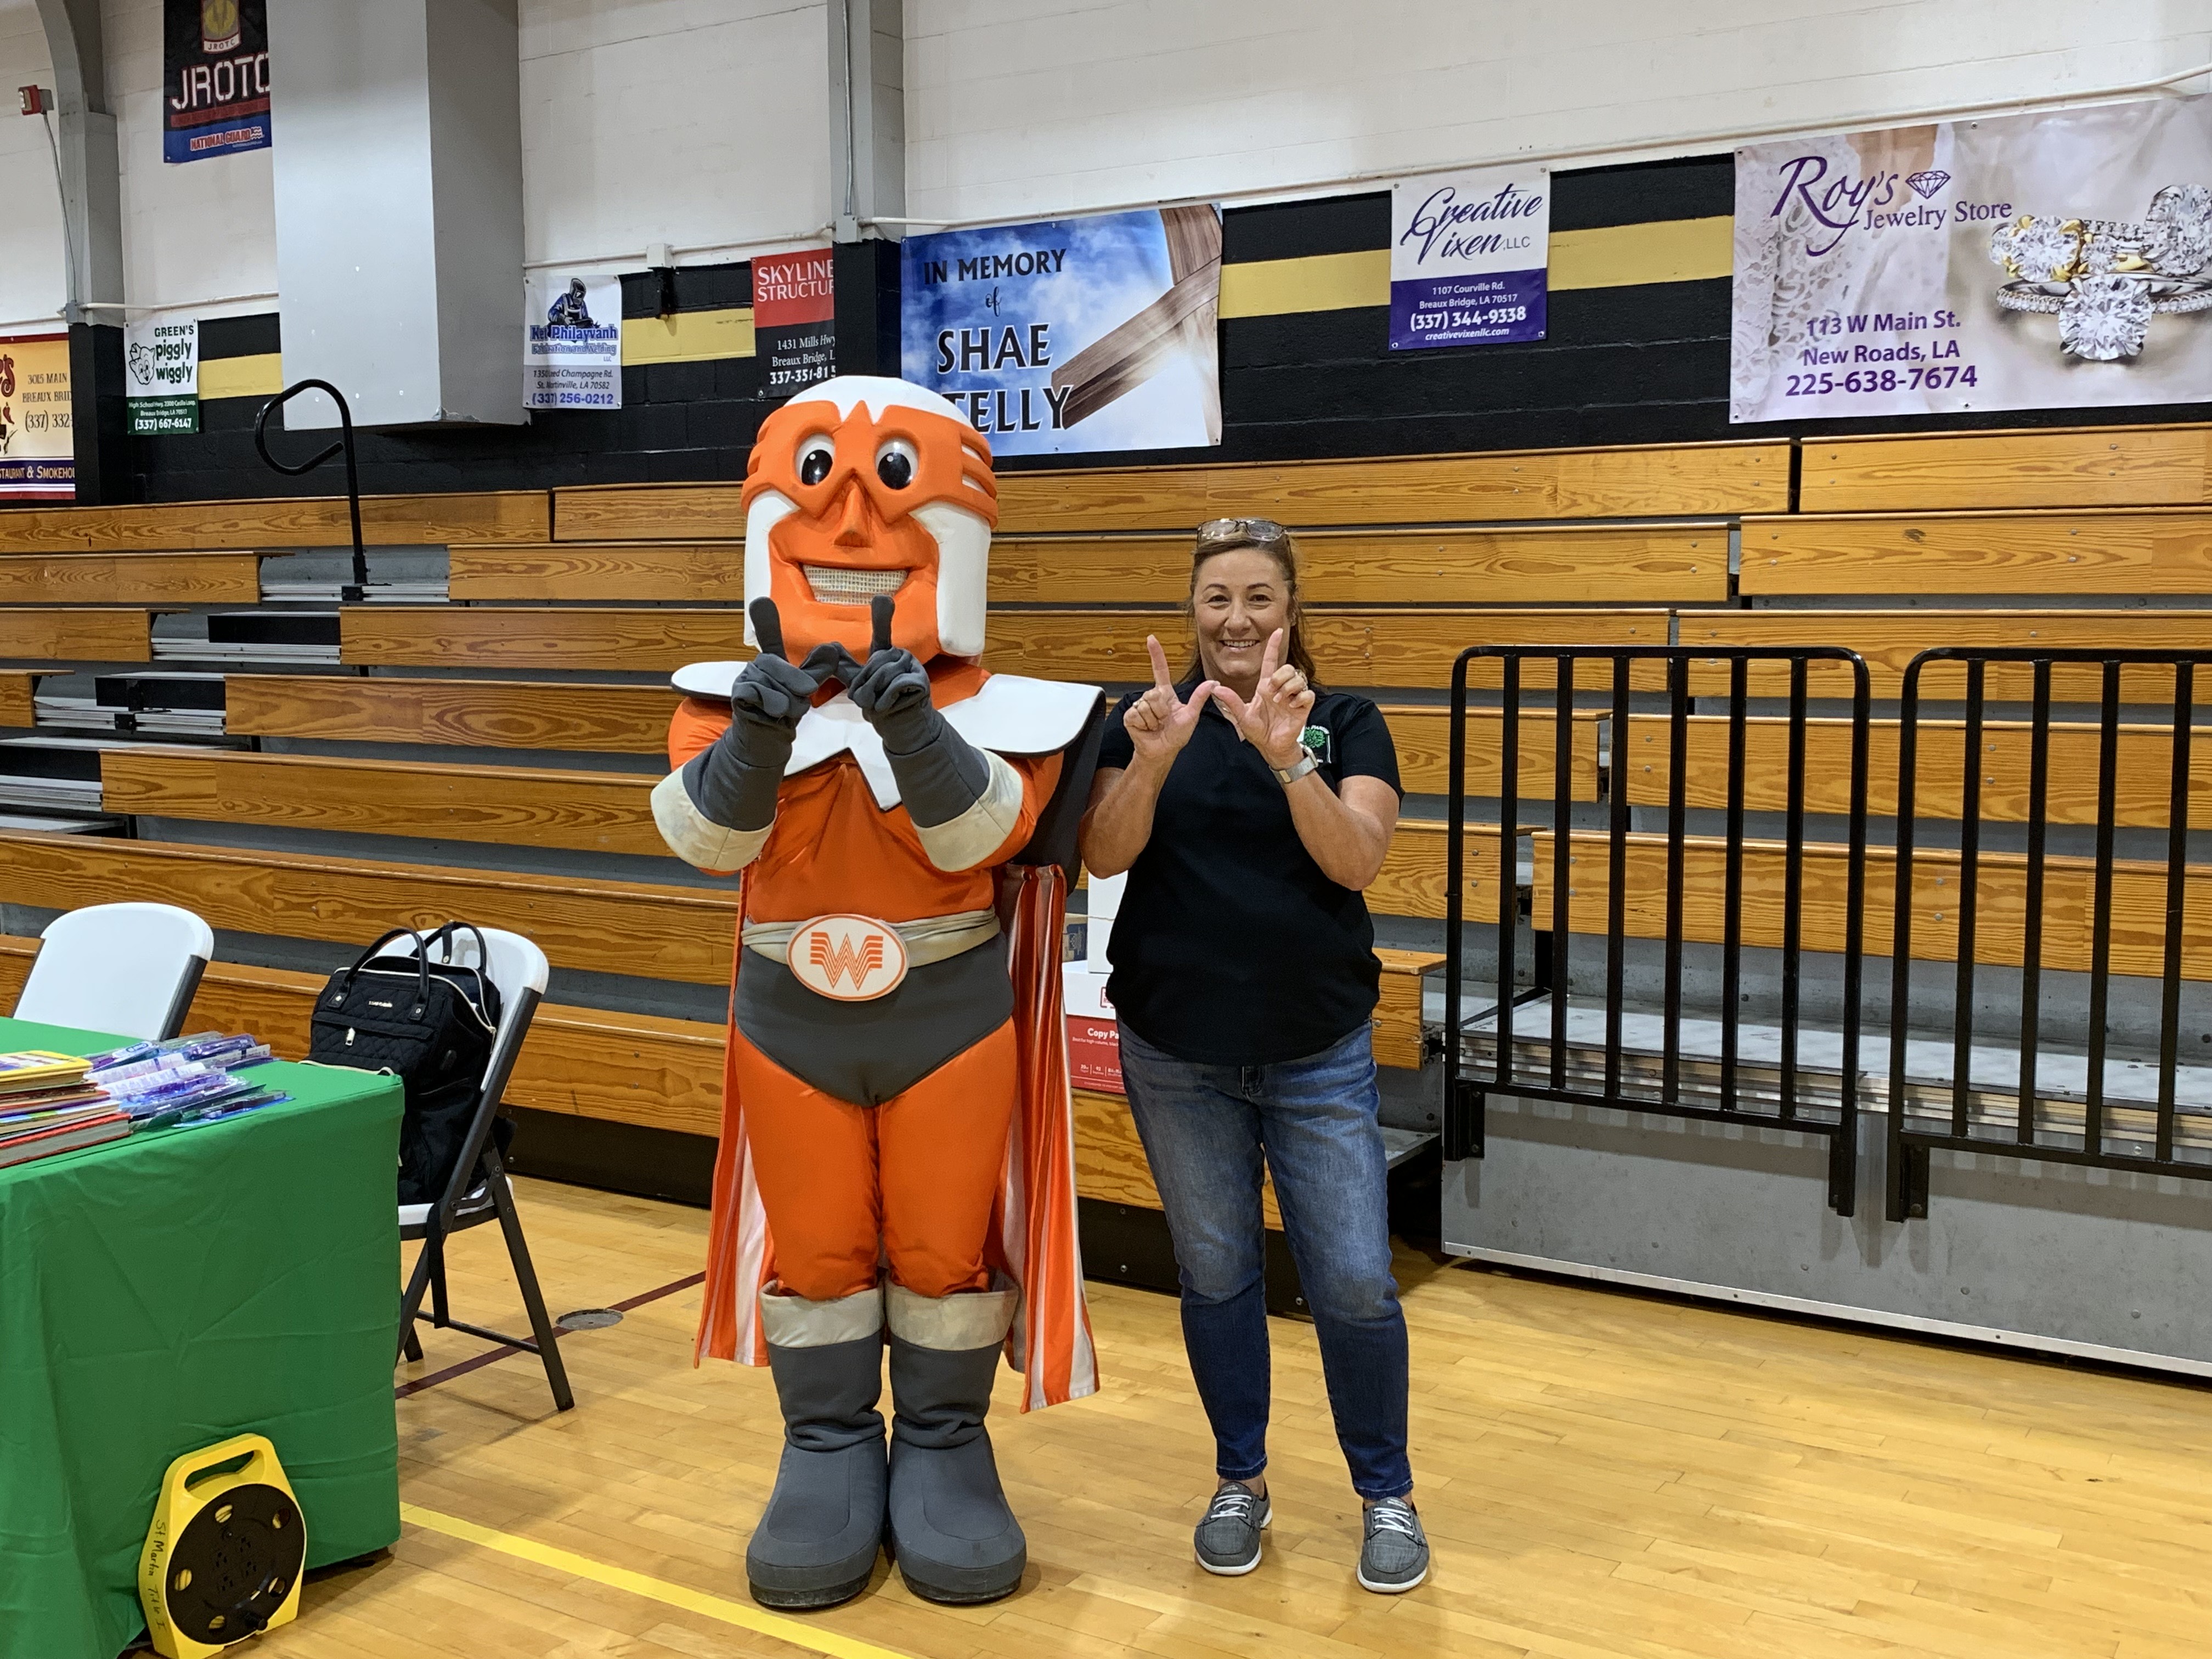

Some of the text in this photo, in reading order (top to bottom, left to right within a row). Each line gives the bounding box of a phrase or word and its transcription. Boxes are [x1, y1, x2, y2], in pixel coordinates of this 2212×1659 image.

[207, 38, 235, 50] JROTC
[171, 53, 270, 110] JROTC
[190, 133, 225, 151] NATIONAL
[224, 128, 251, 145] GUARD
[1410, 183, 1544, 237] Creative
[1770, 156, 1898, 257] Roy's
[1864, 200, 2013, 230] Jewelry Store
[1400, 216, 1504, 265] Vixen
[758, 259, 834, 285] SKYLINE
[924, 248, 1067, 285] IN MEMORY
[1432, 281, 1505, 295] 1107 Courville Rd.
[985, 286, 1002, 317] of
[1419, 294, 1518, 309] Breaux Bridge, LA 70517
[1410, 306, 1527, 332] (337) 344-9338
[1807, 310, 1961, 336] 113 W Main St.
[154, 325, 194, 337] GREEN'S
[550, 324, 619, 344] Philayvanh
[1425, 328, 1510, 341] creativevixenllc.com
[155, 338, 192, 360] piggly
[777, 338, 797, 351] 1431
[799, 335, 819, 349] Mills
[936, 322, 1054, 375] SHAE
[1803, 340, 1961, 366] New Roads, LA
[771, 356, 802, 368] Breaux
[803, 351, 827, 365] Bridge,
[46, 373, 67, 384] MAIN
[155, 362, 193, 384] wiggly
[561, 369, 603, 380] Champagne
[604, 369, 613, 378] Rd.
[1785, 365, 1978, 397] 225-638-7674
[22, 392, 52, 403] BREAUX
[532, 392, 614, 405] (337) 256-0212
[25, 410, 72, 433] (337) 332-
[135, 417, 192, 431] (337) 667-6147
[26, 465, 34, 479] &
[1087, 1028, 1108, 1040] Copy
[148, 1540, 166, 1576] Martin
